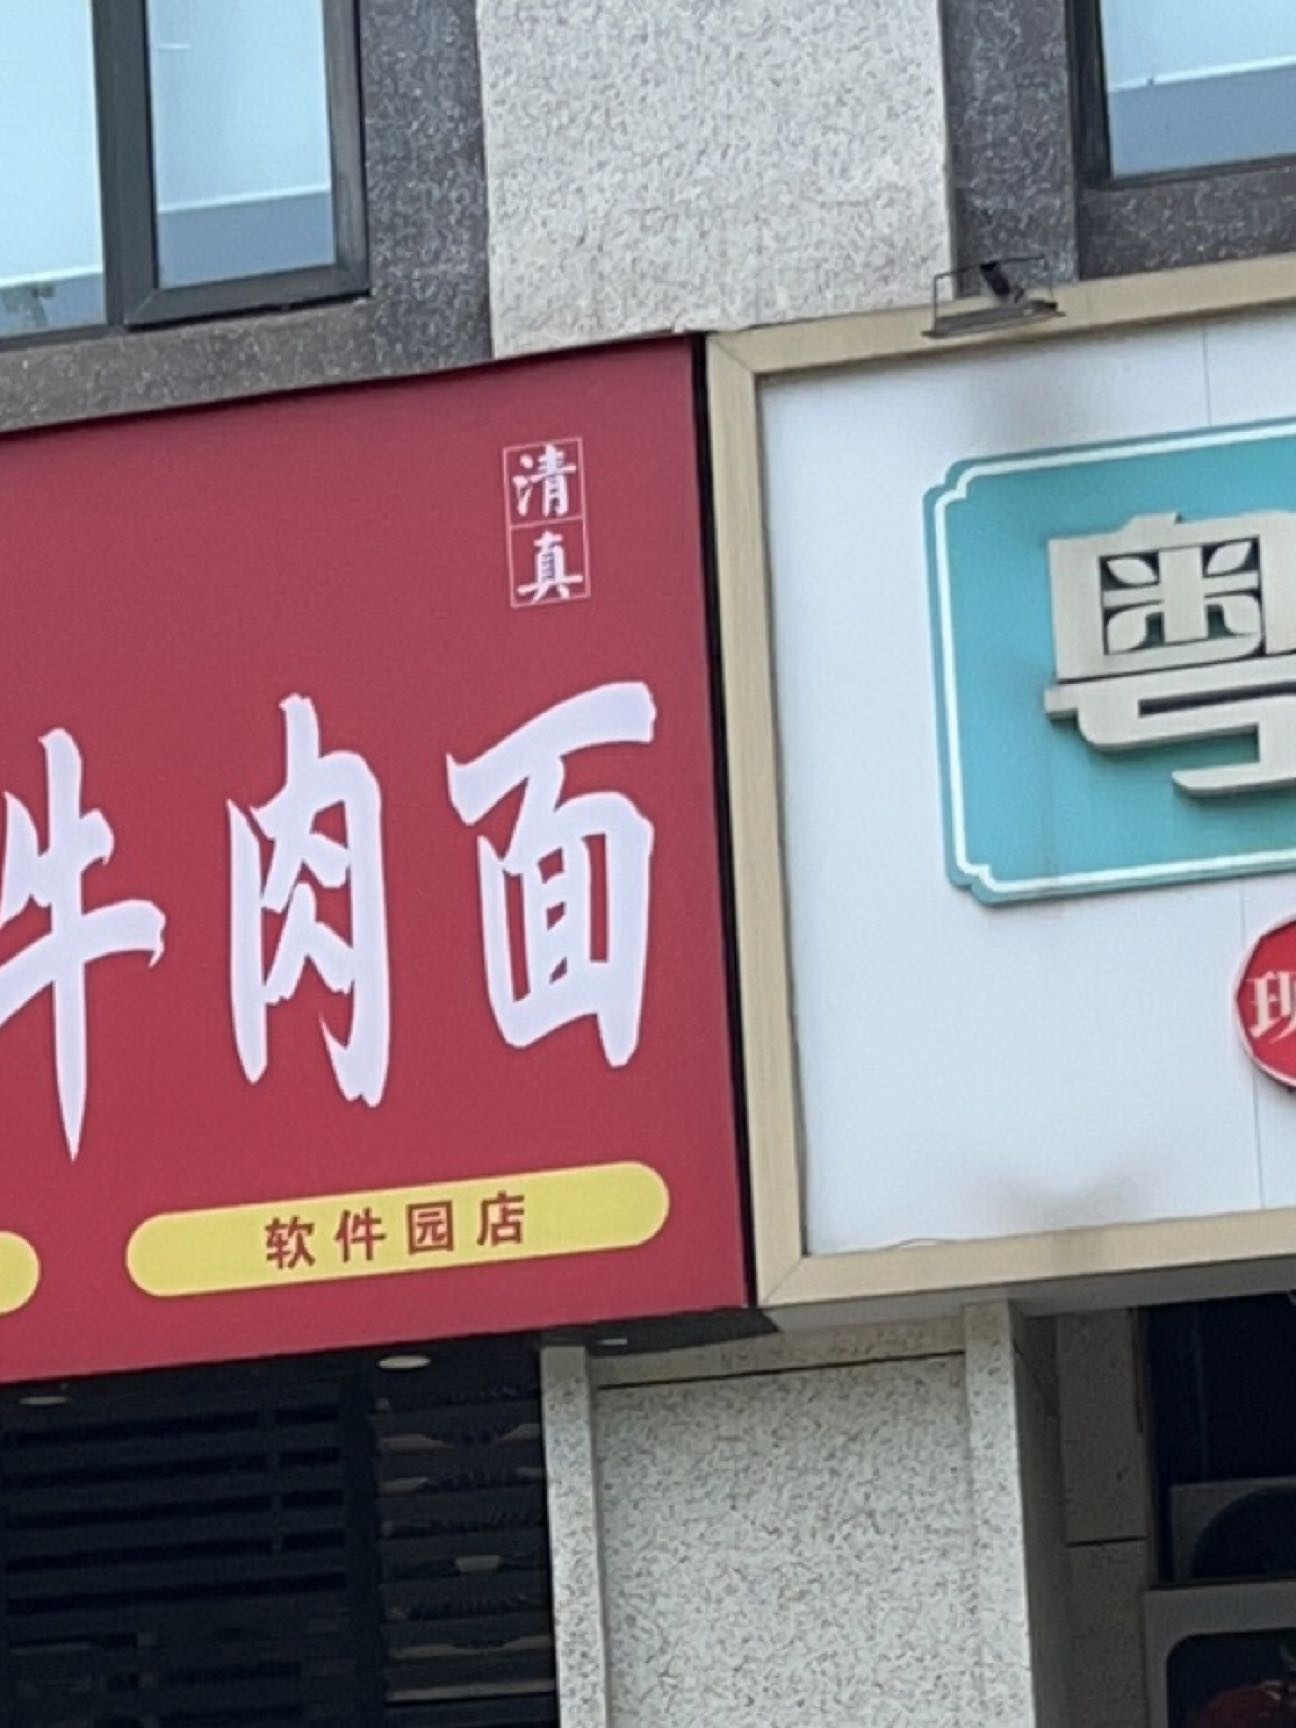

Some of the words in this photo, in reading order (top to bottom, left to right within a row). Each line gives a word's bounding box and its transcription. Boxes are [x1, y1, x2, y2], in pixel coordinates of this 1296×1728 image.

[512, 443, 584, 604] 清真
[1044, 510, 1296, 796] 粤
[263, 1193, 527, 1272] 软件园店
